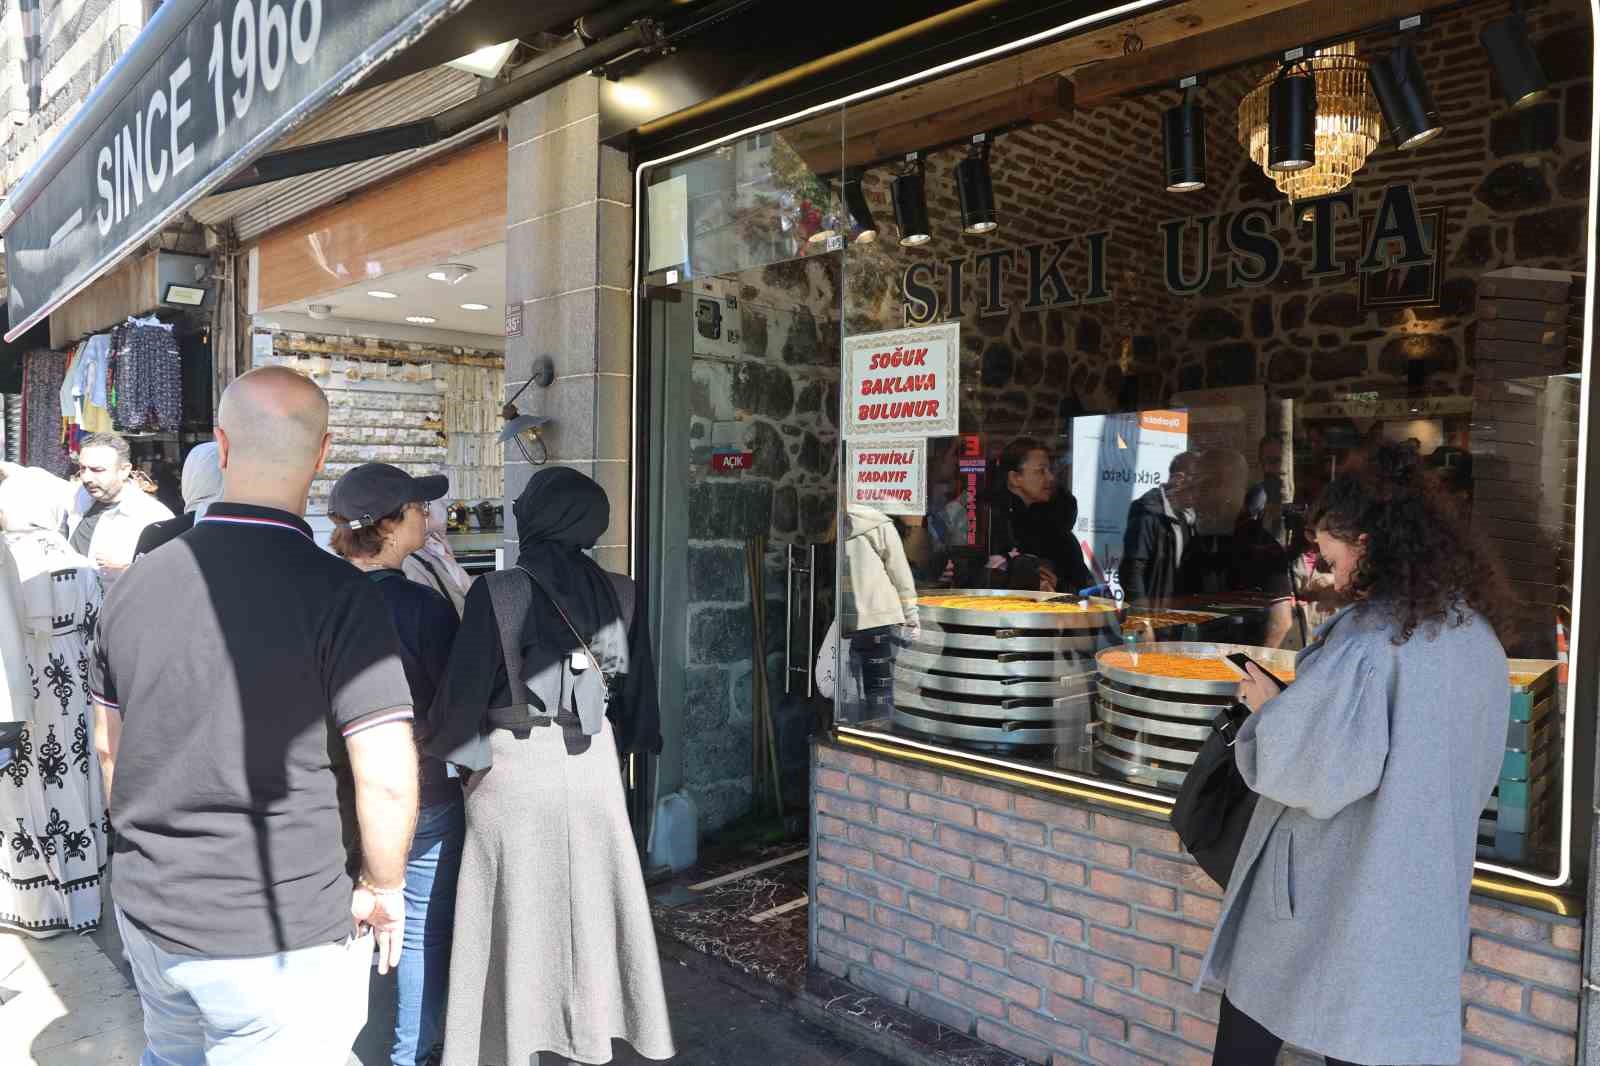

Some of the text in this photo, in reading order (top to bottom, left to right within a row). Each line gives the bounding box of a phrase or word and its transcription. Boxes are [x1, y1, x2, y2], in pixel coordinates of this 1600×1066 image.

[97, 57, 195, 237] SINCE
[902, 183, 1434, 329] SITKI USTA
[869, 347, 928, 370] SOĞUK
[860, 373, 936, 396] BAKLAVA
[857, 399, 940, 420] BULUNUR
[722, 455, 744, 469] AÇIK
[857, 450, 914, 465] PEYNİRLİ
[857, 471, 908, 484] KADAYIF
